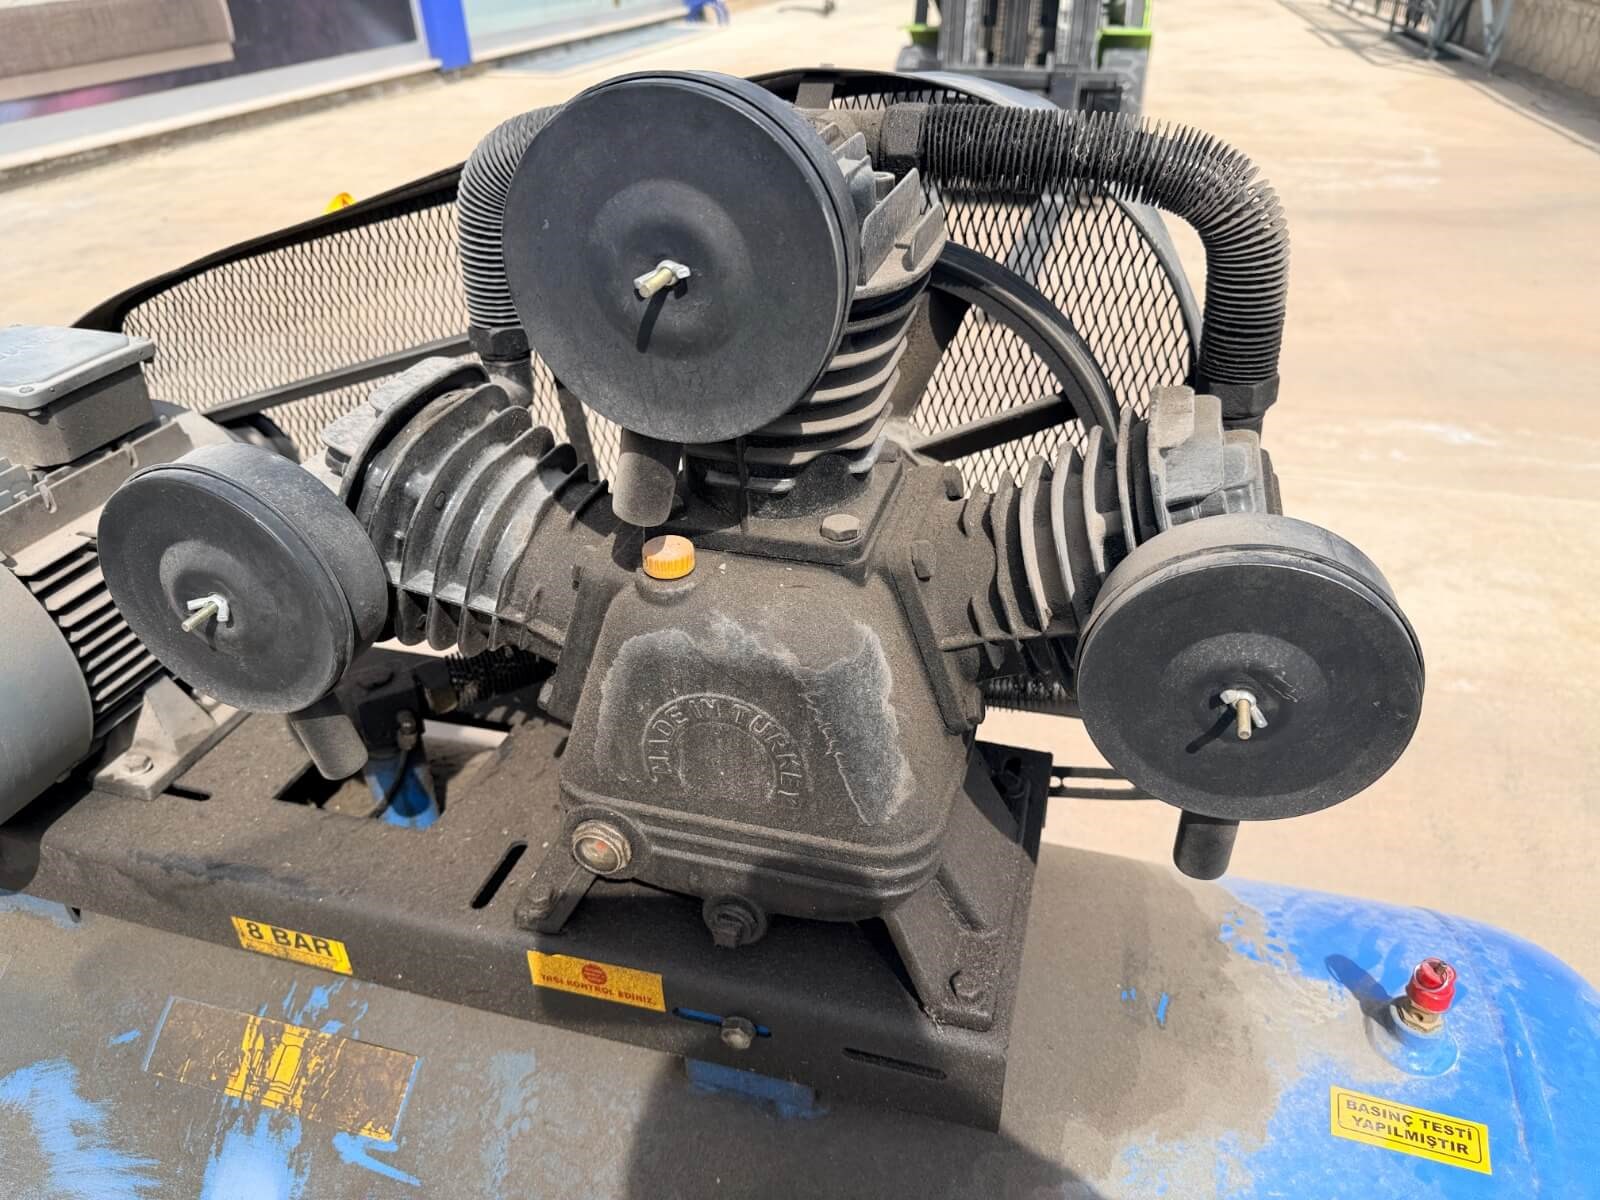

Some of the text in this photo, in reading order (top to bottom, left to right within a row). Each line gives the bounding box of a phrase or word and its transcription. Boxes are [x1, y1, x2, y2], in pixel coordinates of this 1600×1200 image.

[246, 921, 334, 958] 8 BAR
[566, 977, 615, 997] KONTROL
[1346, 1099, 1473, 1141] BASINÇ TESTİ
[1351, 1114, 1470, 1155] YAPILMIŞTIR
